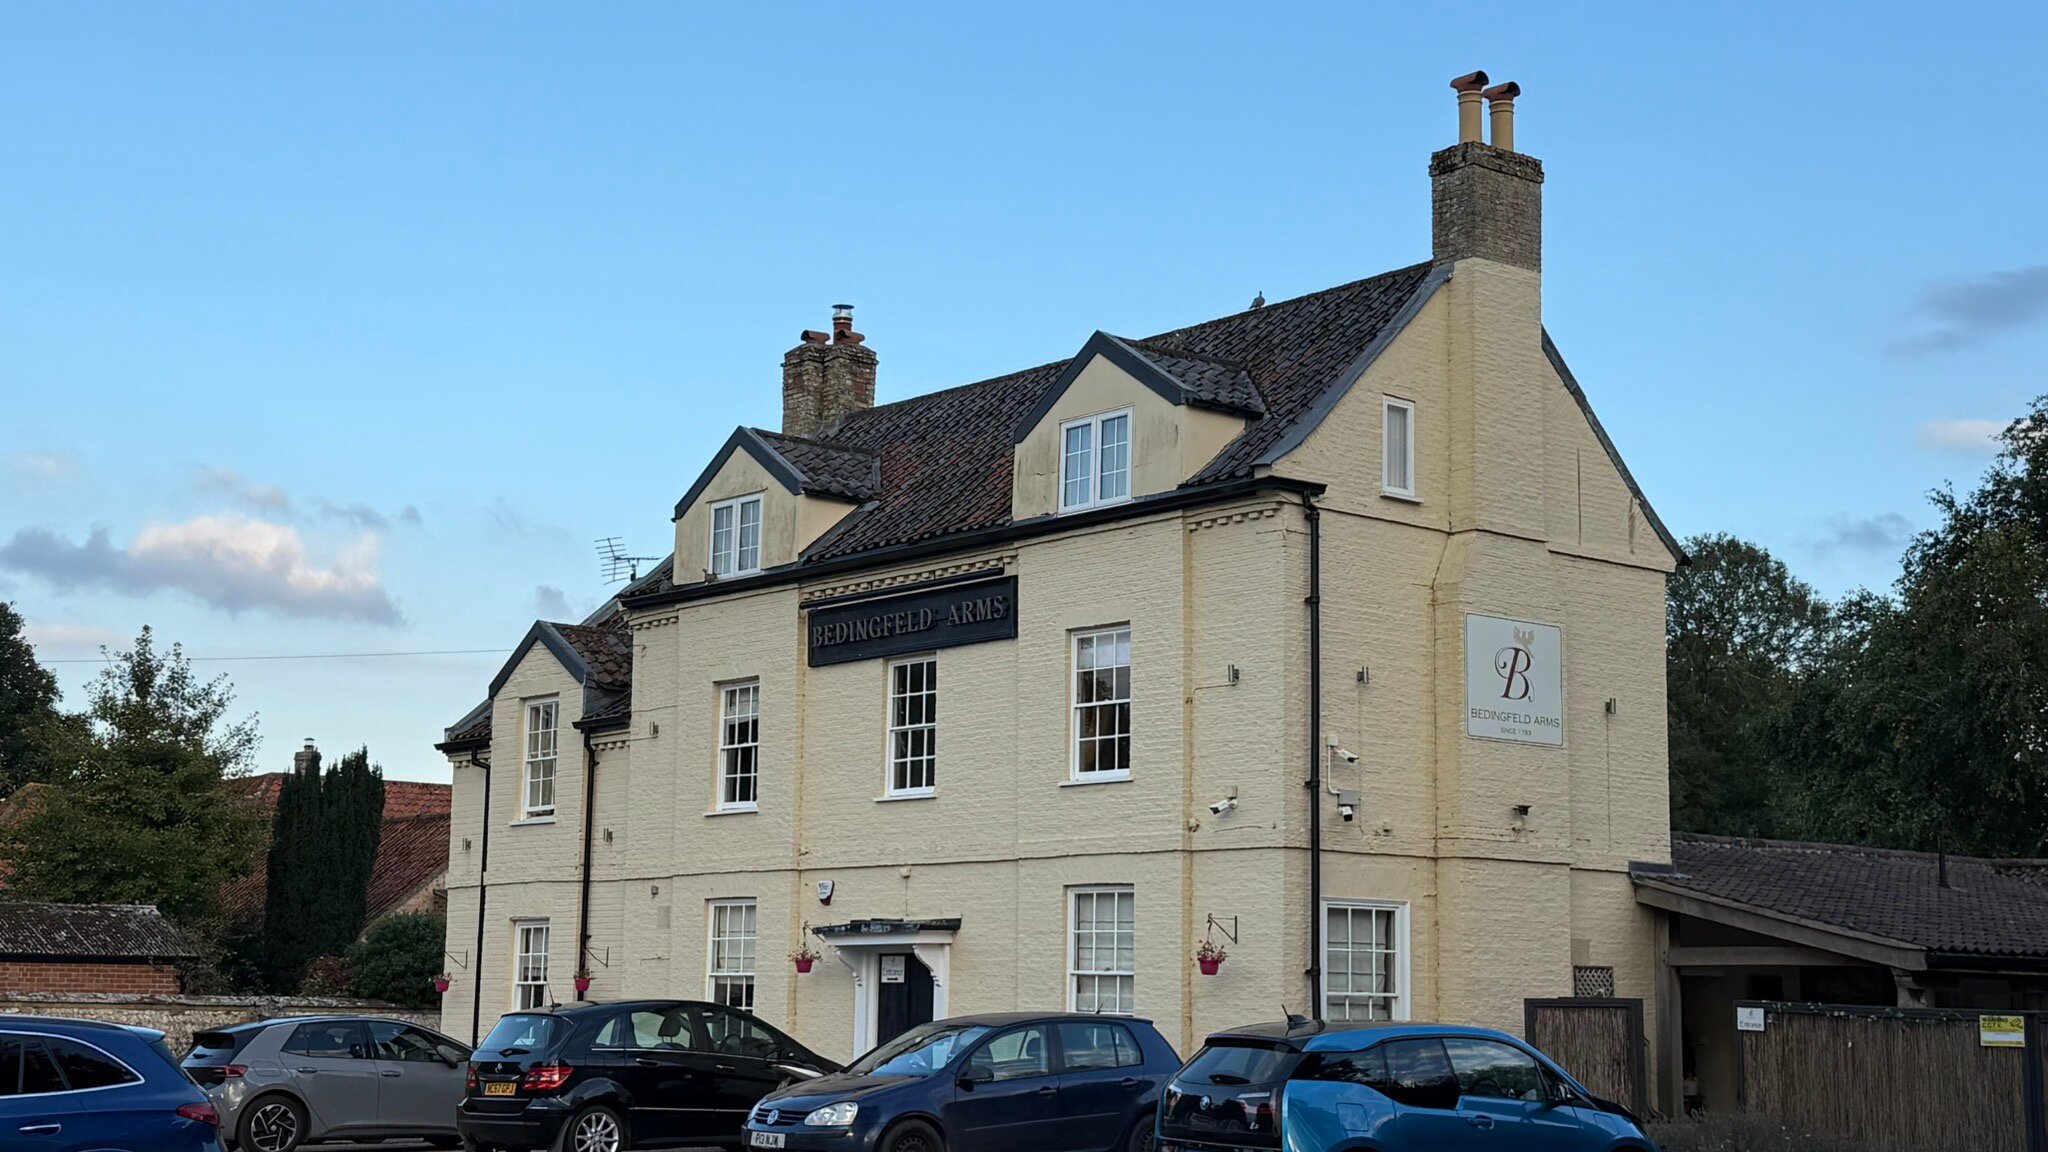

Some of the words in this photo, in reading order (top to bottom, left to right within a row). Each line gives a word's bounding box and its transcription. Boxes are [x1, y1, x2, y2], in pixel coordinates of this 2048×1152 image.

[812, 607, 934, 648] BEDINGFELD
[948, 595, 1008, 626] ARMS
[1494, 646, 1536, 703] B
[1470, 707, 1532, 725] BEDINGFELD
[1534, 717, 1560, 729] ARMS
